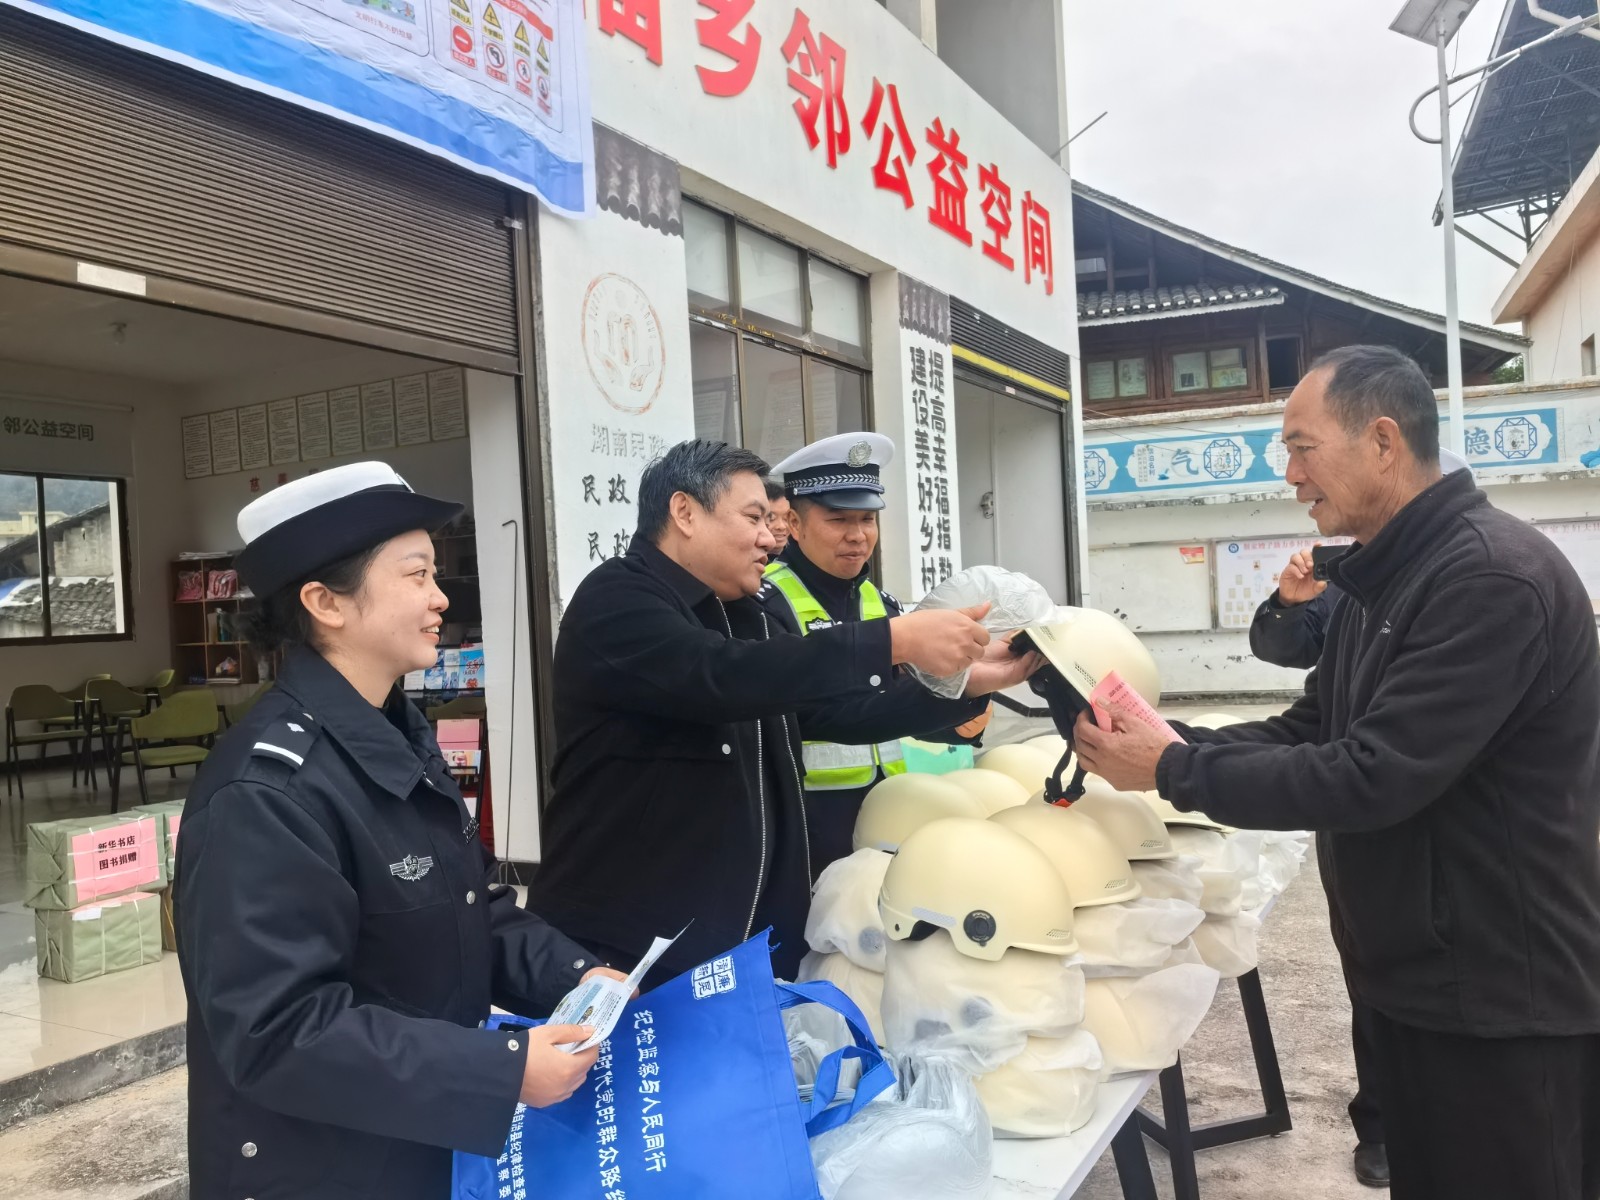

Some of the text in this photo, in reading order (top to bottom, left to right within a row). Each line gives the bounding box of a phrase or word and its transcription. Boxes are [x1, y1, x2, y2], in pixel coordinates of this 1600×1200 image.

[3, 416, 94, 441] 邻公益空间
[1464, 427, 1491, 456] 德
[910, 346, 936, 592] 建设美好乡村
[1171, 448, 1199, 476] 气
[582, 473, 631, 506] 民政
[587, 528, 630, 562] 民政
[98, 835, 135, 853] 新华书店
[99, 851, 137, 870] 图书捐赠
[634, 1009, 667, 1172] 纪检监察与人民同行
[496, 1139, 511, 1199] 监察委
